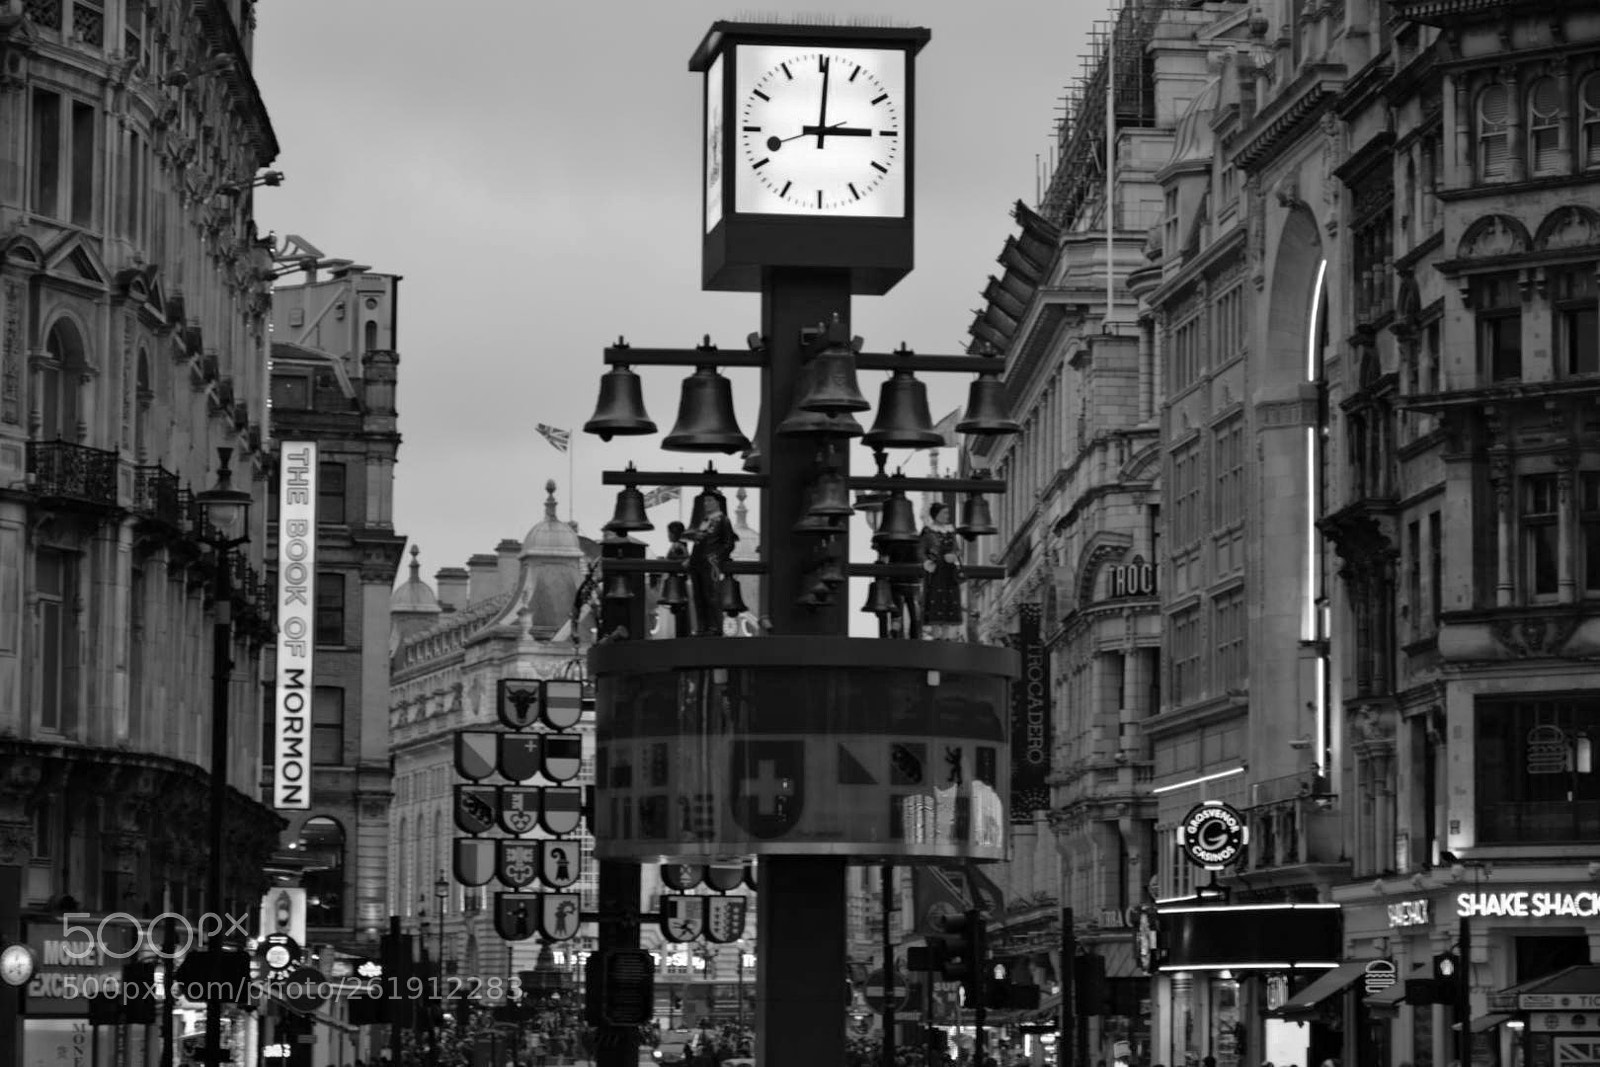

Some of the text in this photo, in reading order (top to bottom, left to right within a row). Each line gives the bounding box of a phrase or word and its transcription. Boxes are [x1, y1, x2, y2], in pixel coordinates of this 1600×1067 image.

[282, 447, 310, 804] THE BOOK OF MORMON
[1027, 645, 1044, 764] TROCADERO
[1187, 809, 1240, 833] GROSVENOR
[1192, 846, 1236, 862] CASINOS
[1457, 892, 1528, 916] SHAKE
[44, 940, 107, 966] MONEY
